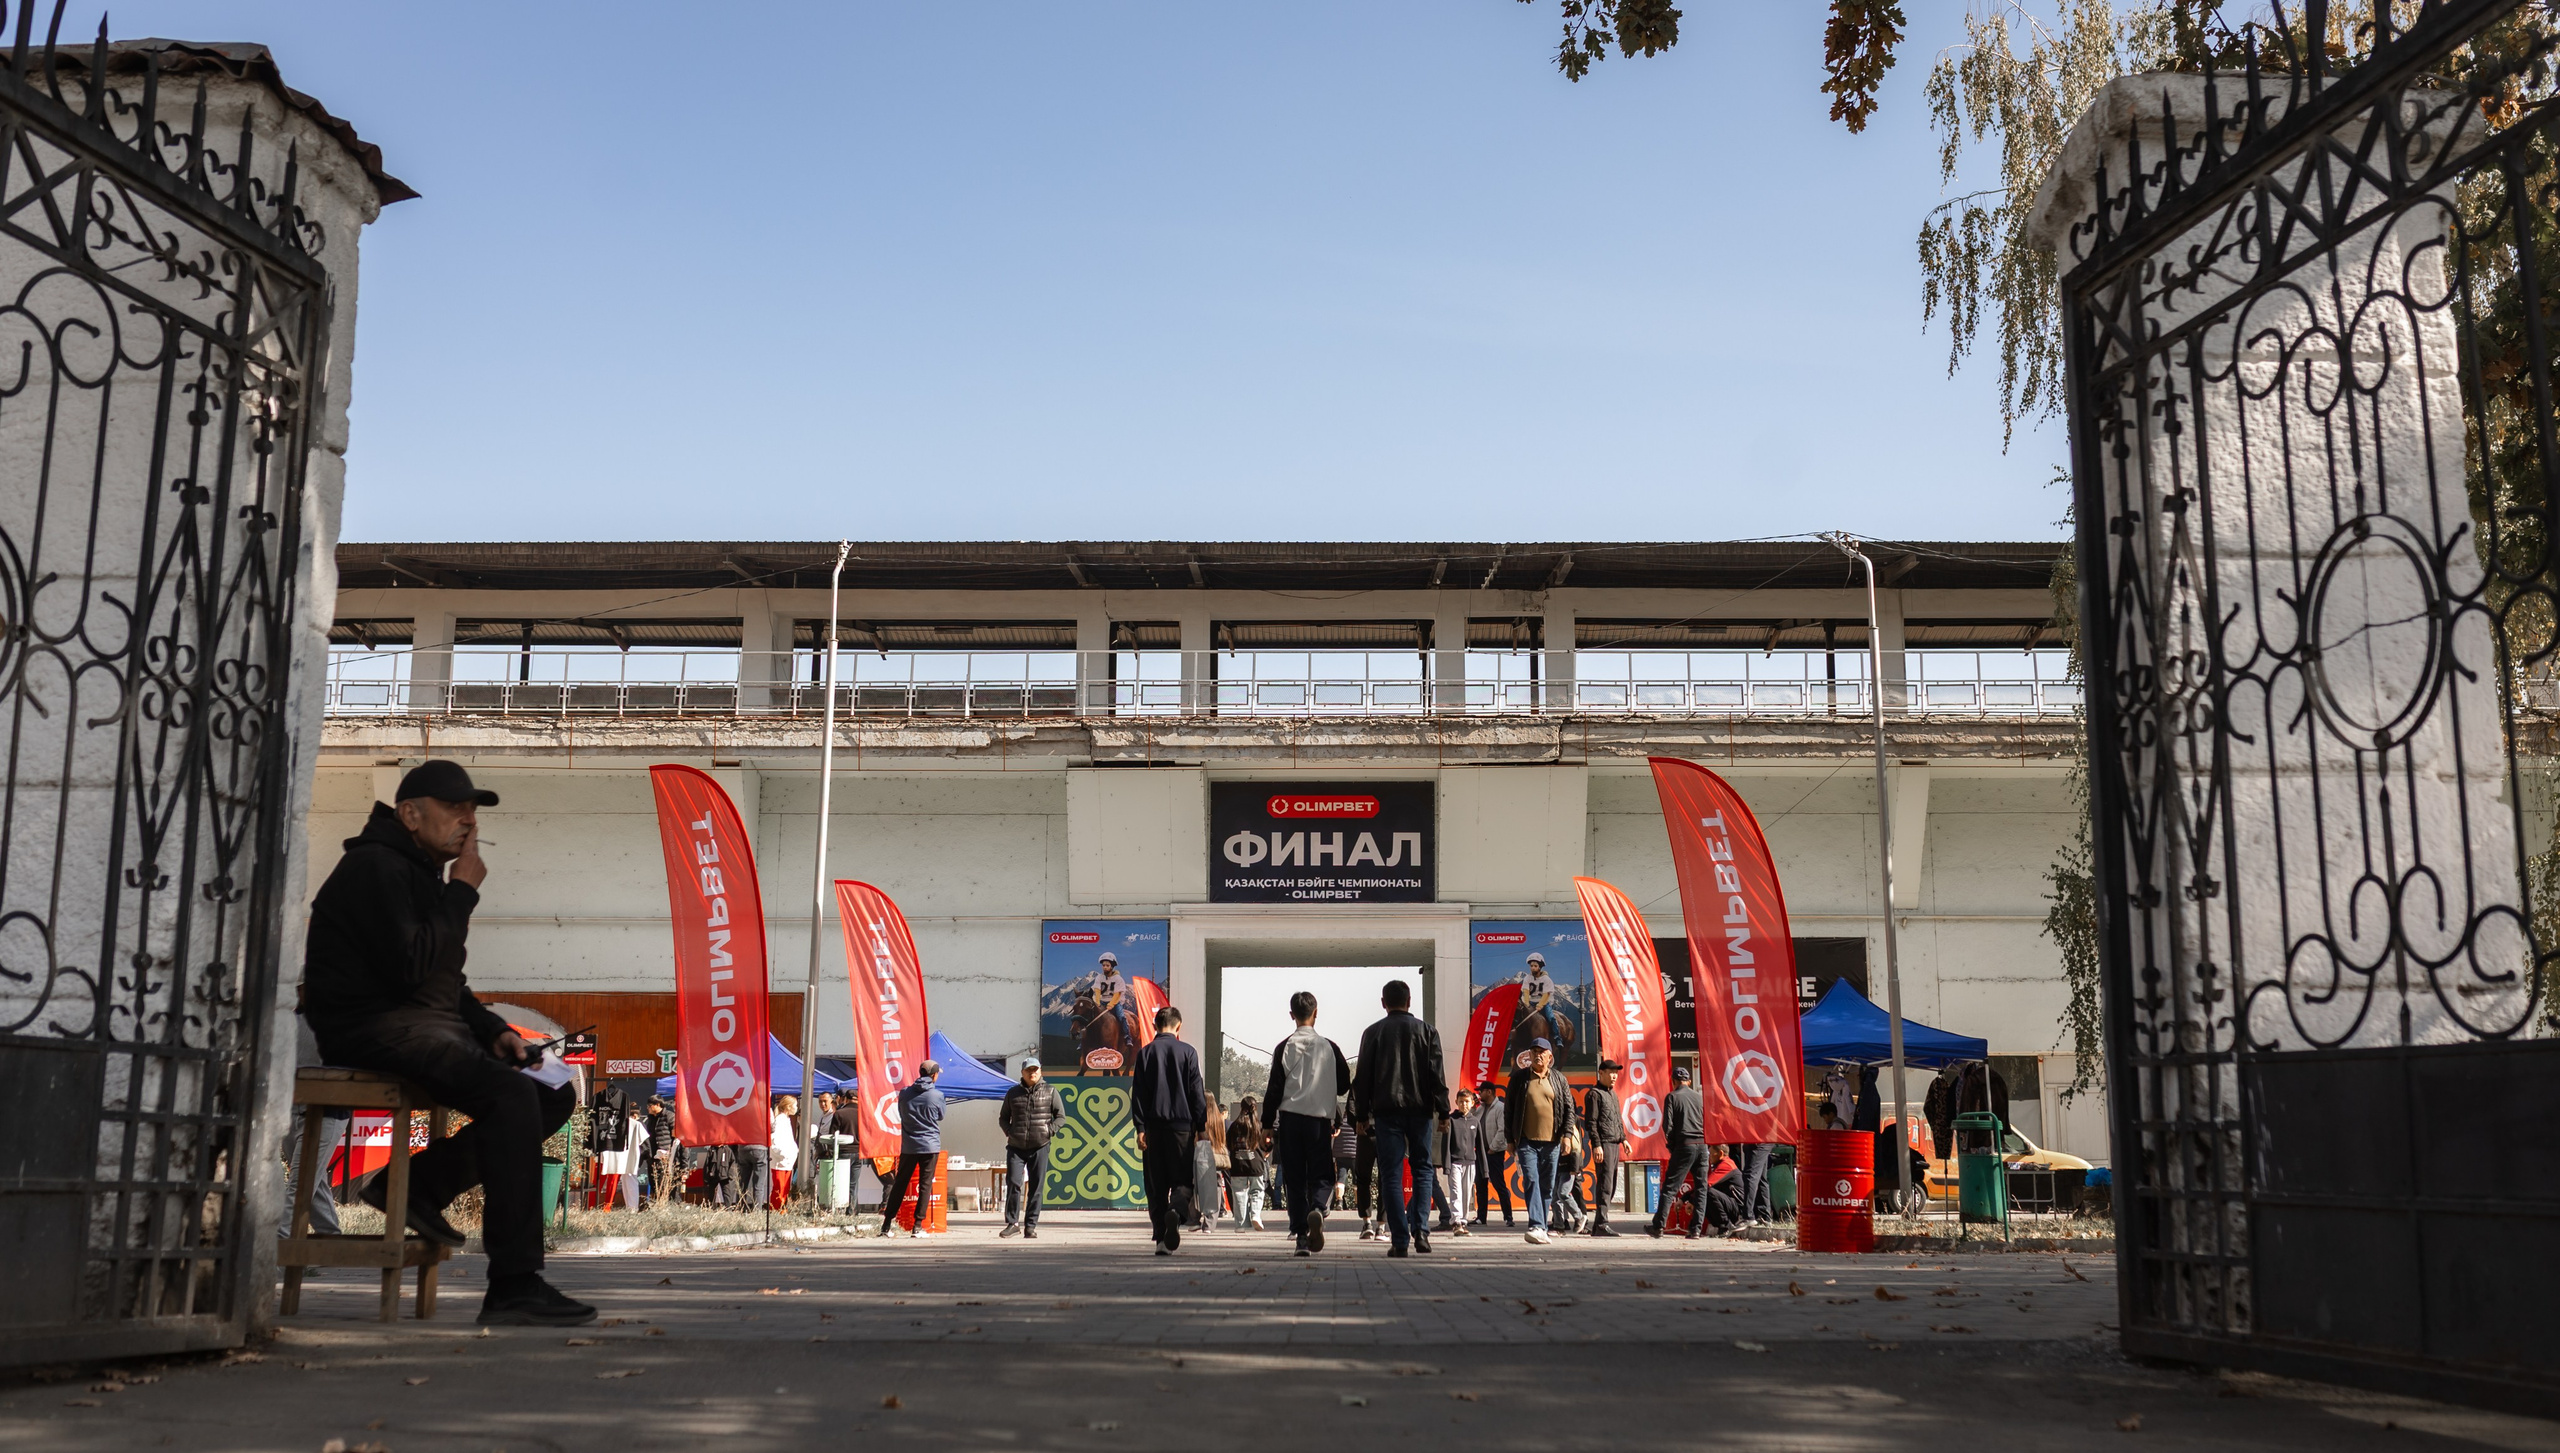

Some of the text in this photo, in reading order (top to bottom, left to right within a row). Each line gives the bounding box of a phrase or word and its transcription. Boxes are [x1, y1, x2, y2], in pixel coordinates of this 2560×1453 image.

[1293, 801, 1375, 812] OLIMPBET
[1223, 830, 1422, 868] ФИНАЛ
[1225, 877, 1421, 889] ҚАЗАҚСТАН БӘЙГЕ ЧЕМПИОНАТЫ
[1292, 890, 1362, 899] OLIMPBET
[606, 1060, 654, 1073] KAFESI
[657, 1049, 677, 1073] T
[1812, 1197, 1870, 1207] OLIMPBET
